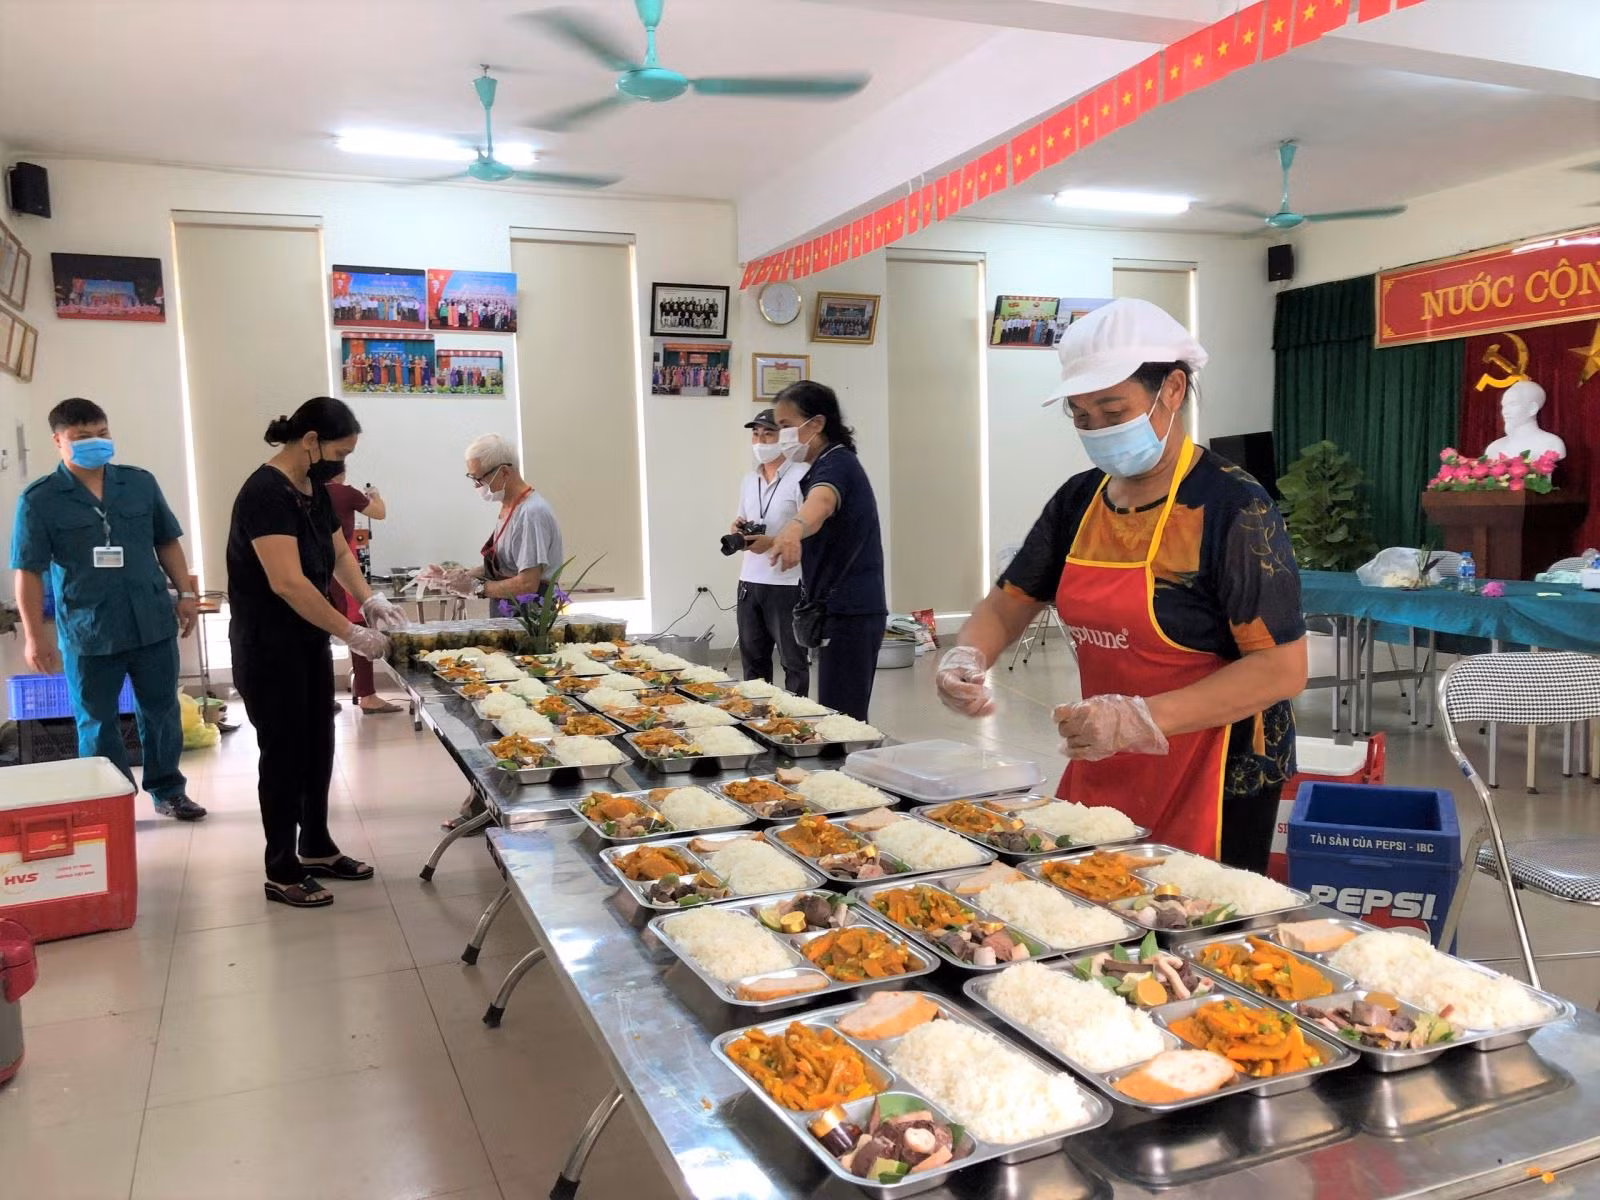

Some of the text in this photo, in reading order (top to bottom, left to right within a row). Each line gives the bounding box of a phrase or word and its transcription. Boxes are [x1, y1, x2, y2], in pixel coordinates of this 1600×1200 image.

[1420, 272, 1515, 321] NƯỚC
[1068, 625, 1129, 649] eptune
[1310, 832, 1326, 845] TÀI
[1329, 833, 1349, 847] SẢN
[1352, 835, 1373, 848] CỦA
[1375, 840, 1407, 851] PEPSI
[1416, 843, 1434, 853] IBC
[4, 872, 39, 886] HVS
[1310, 885, 1437, 920] PEPSI
